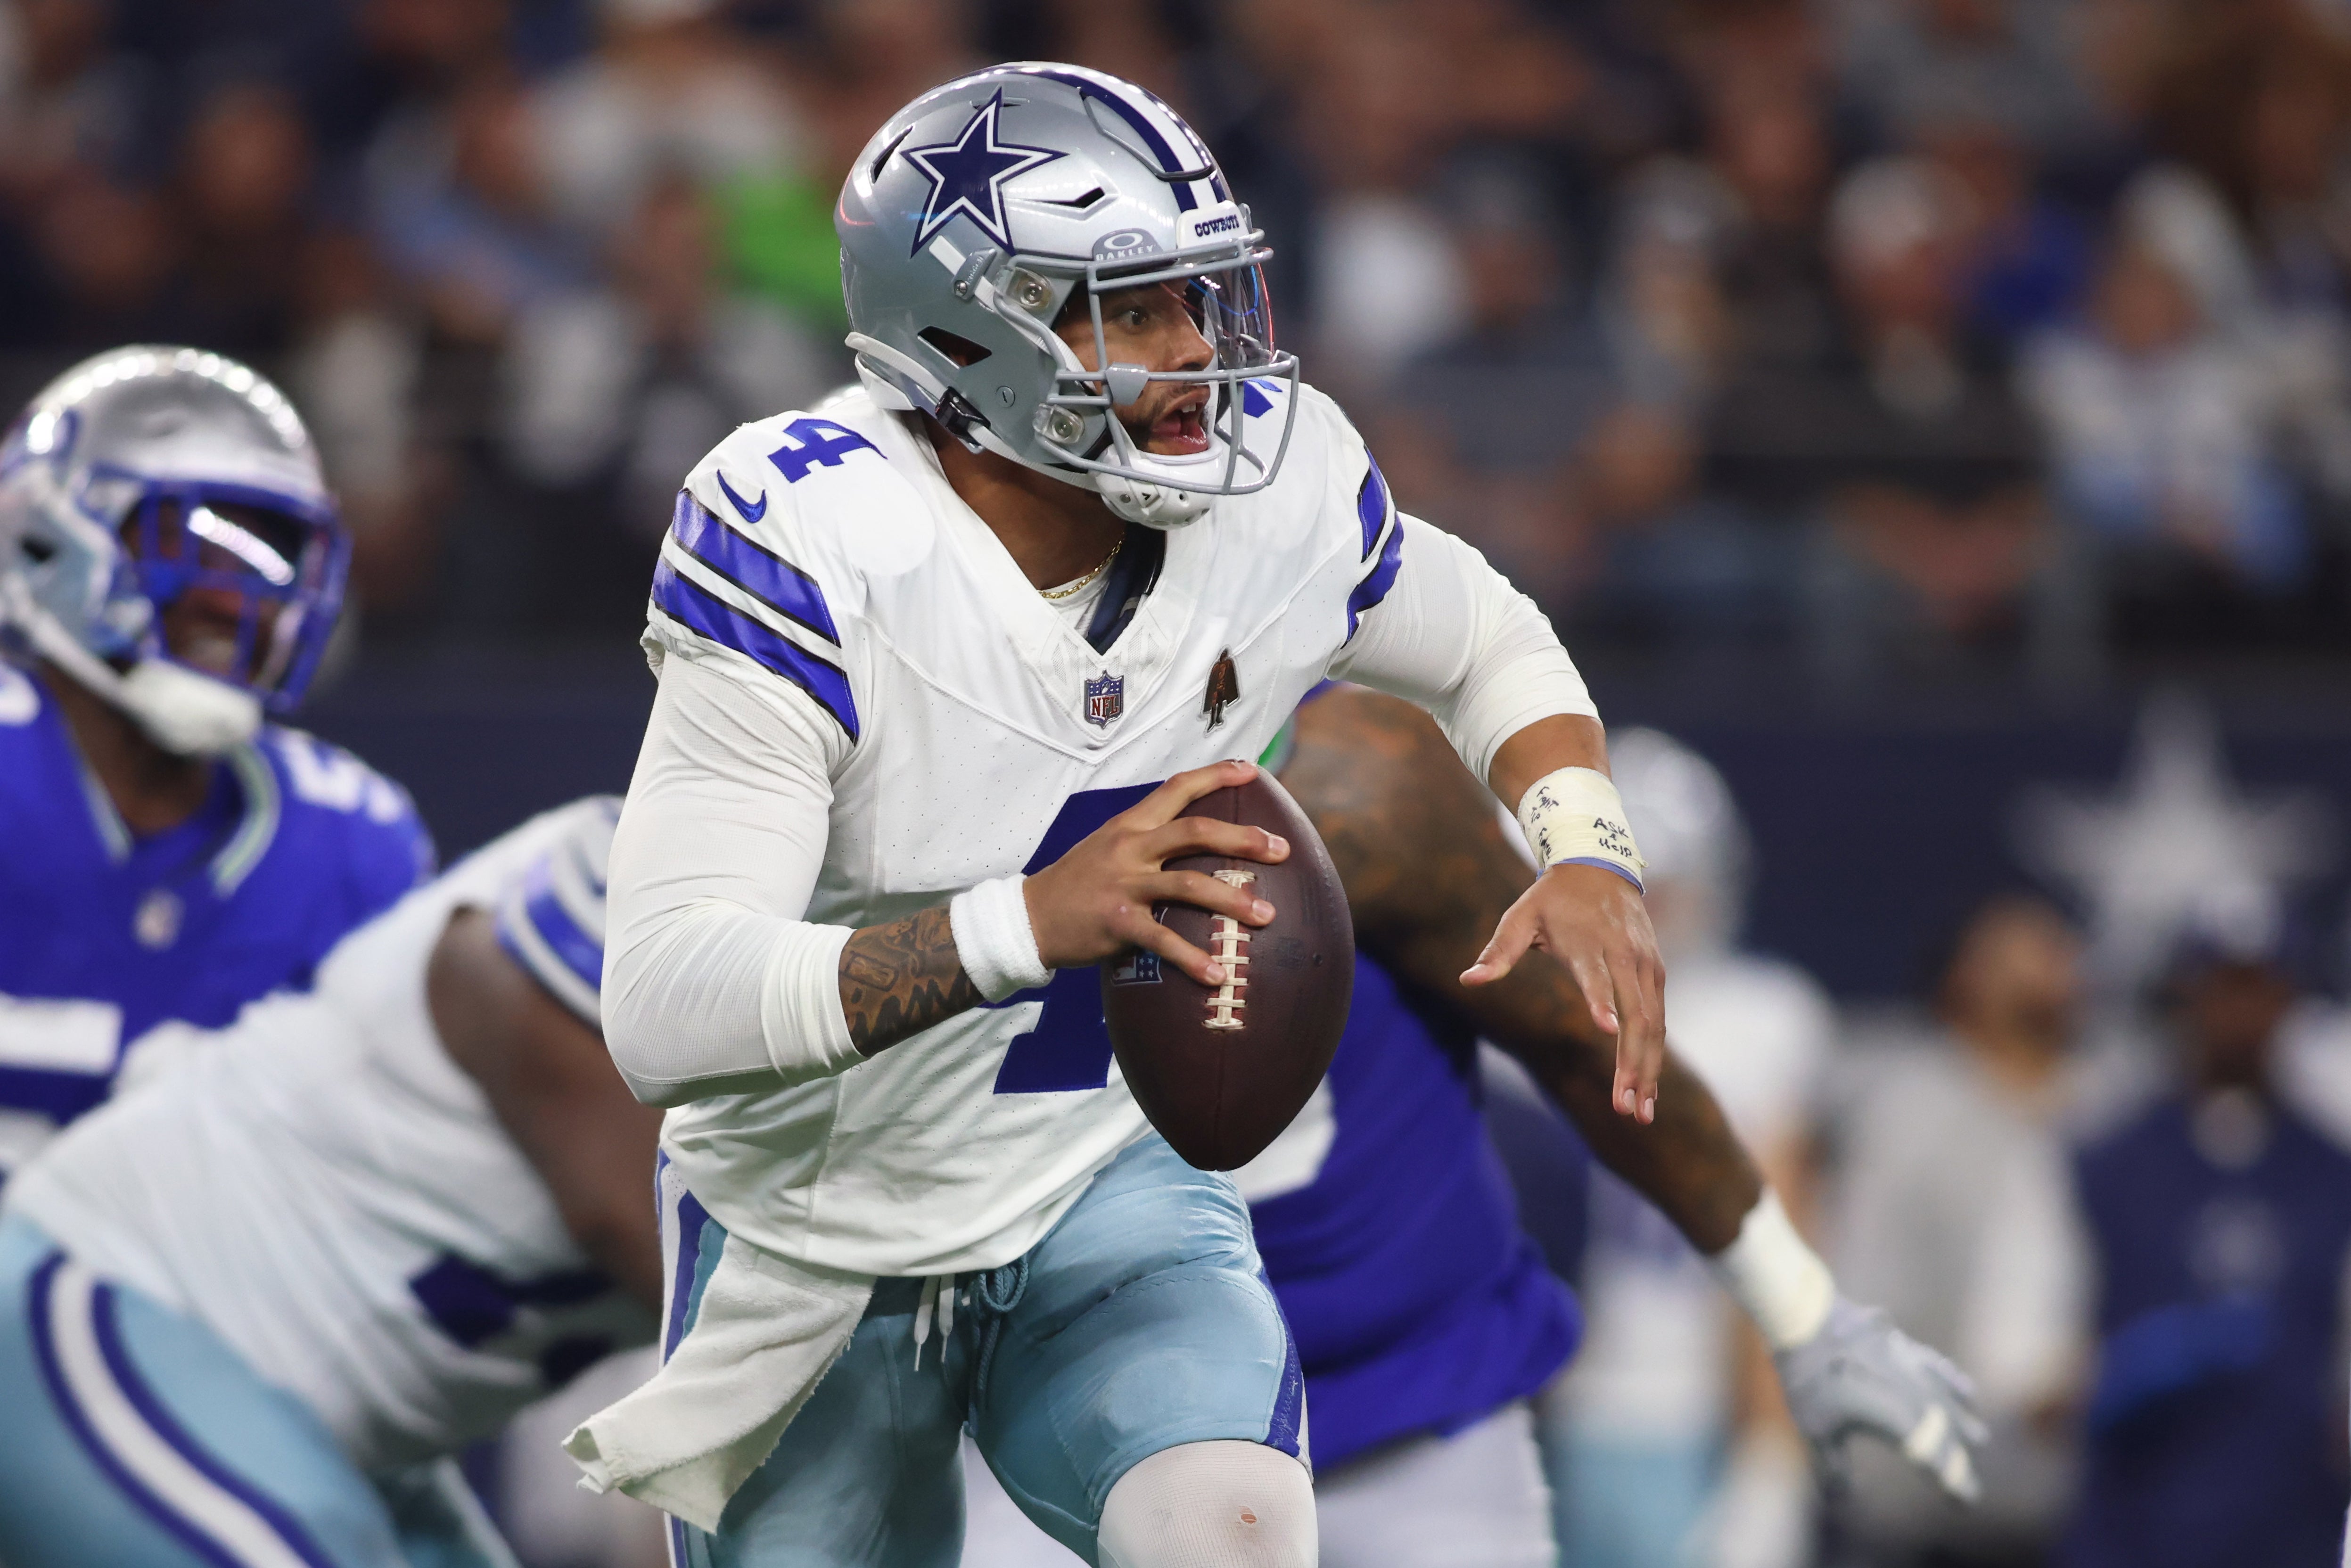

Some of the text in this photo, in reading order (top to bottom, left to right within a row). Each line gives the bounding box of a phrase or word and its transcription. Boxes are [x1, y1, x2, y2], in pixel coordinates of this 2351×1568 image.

[1096, 245, 1153, 261] OAKLEY
[768, 419, 888, 483] 4
[1091, 696, 1118, 718] NFL
